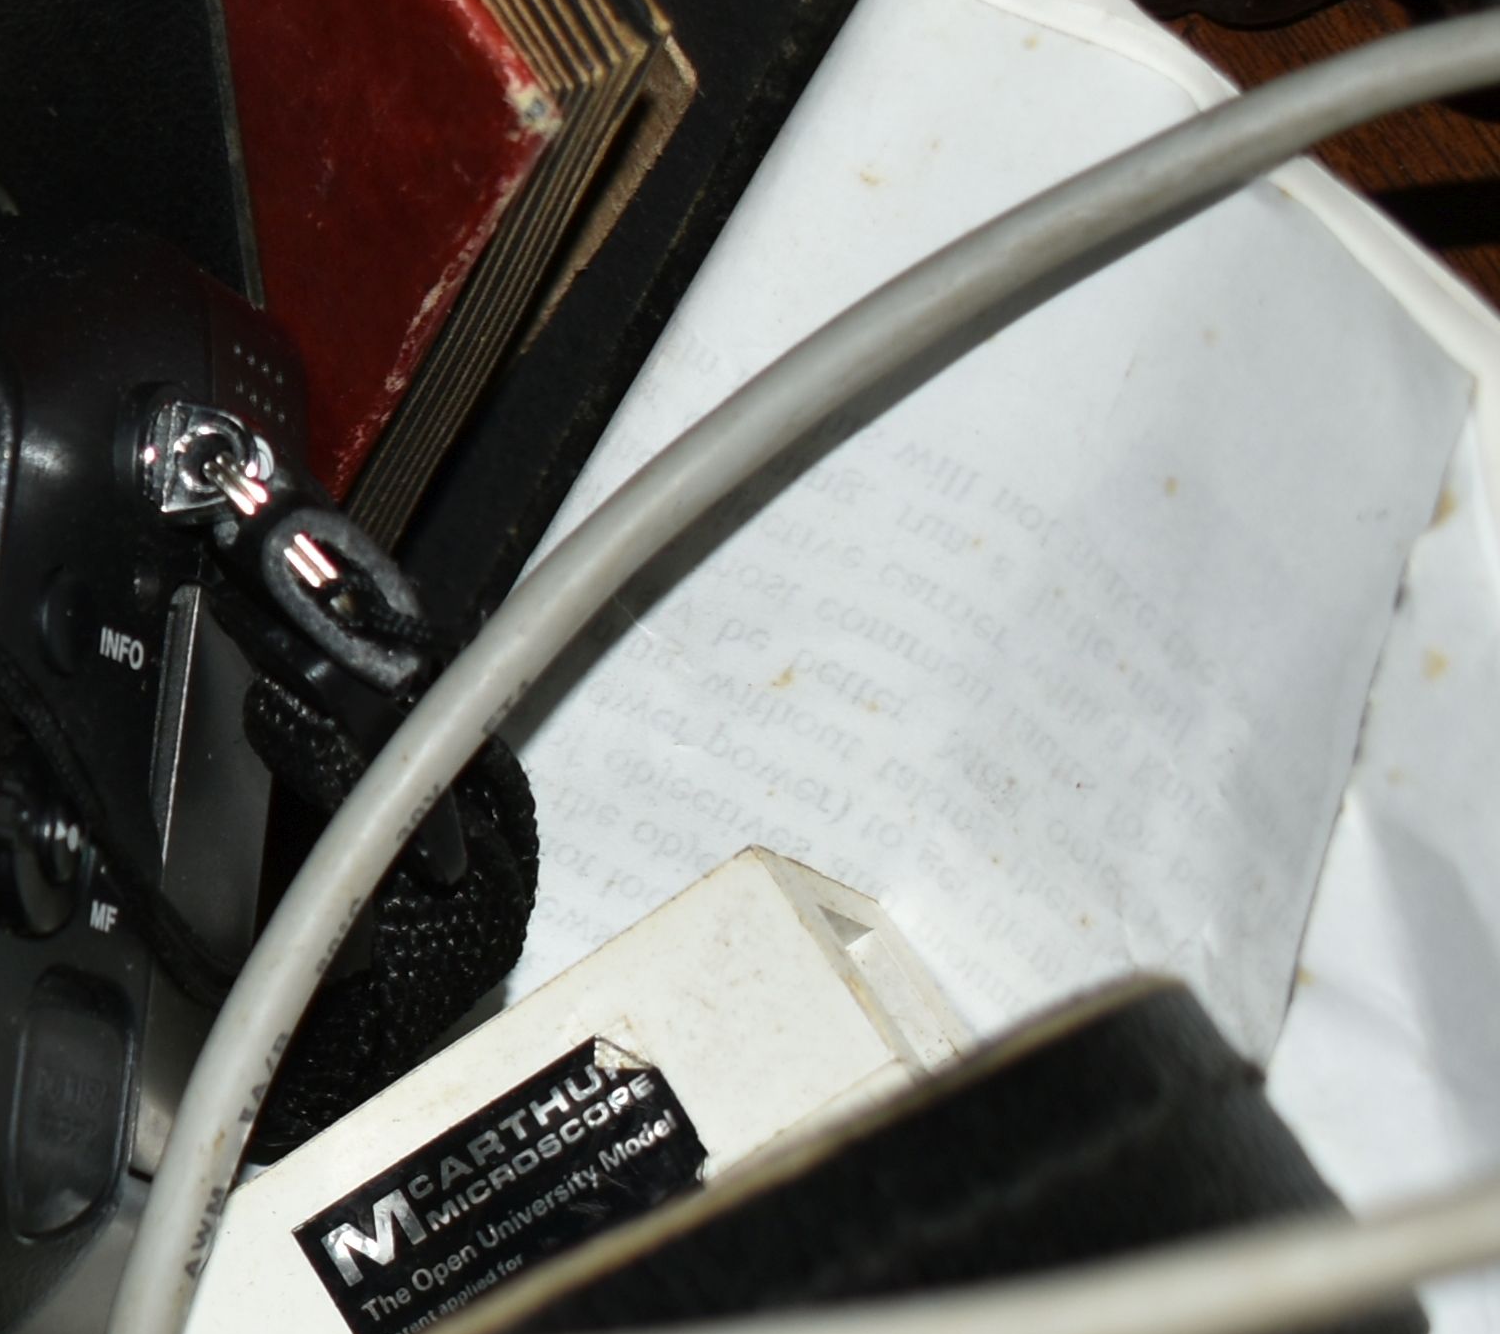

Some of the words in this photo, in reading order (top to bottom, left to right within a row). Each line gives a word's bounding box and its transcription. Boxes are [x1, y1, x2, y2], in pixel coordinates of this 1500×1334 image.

[98, 625, 146, 672] INFO
[89, 899, 120, 935] MF
[426, 1072, 657, 1231] MICROSCOPE
[183, 1184, 228, 1281] AWM
[360, 1283, 412, 1323] The
[411, 1242, 479, 1297] Open
[479, 1164, 601, 1249] University
[598, 1109, 679, 1174] Model
[438, 1269, 500, 1319] applied
[496, 1251, 526, 1281] for
